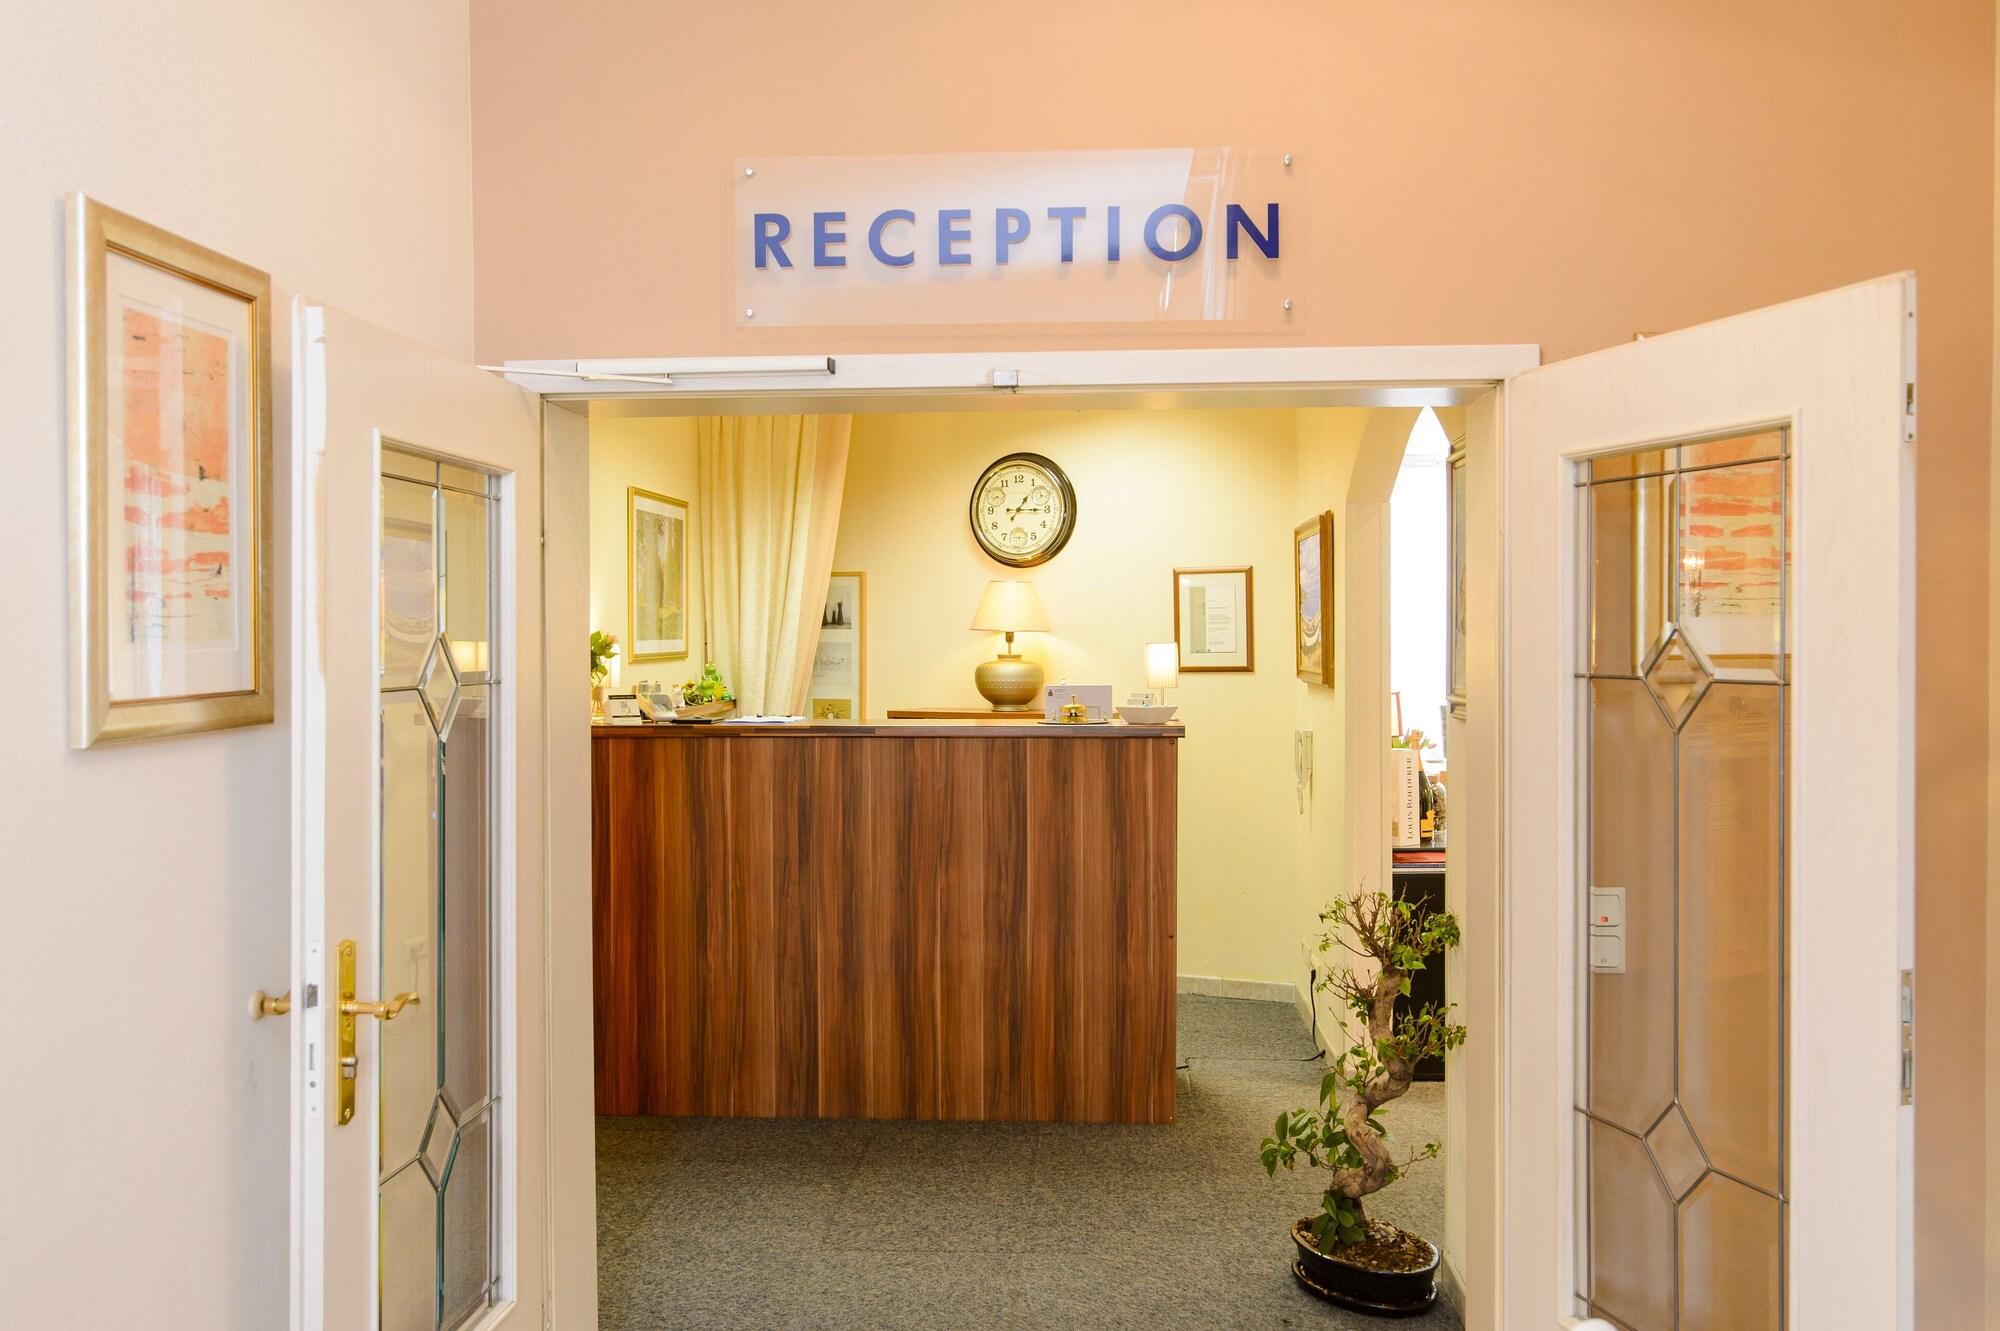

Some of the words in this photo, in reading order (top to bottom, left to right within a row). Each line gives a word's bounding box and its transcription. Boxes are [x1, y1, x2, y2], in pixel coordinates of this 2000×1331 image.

[753, 203, 1280, 268] RECEPTION
[1014, 474, 1024, 483] 12
[1001, 480, 1009, 488] 11
[987, 507, 994, 515] 9
[1044, 505, 1051, 514] 3
[991, 521, 998, 530] 8
[1040, 520, 1047, 529] 4
[1001, 532, 1008, 541] 7
[1030, 532, 1037, 541] 5
